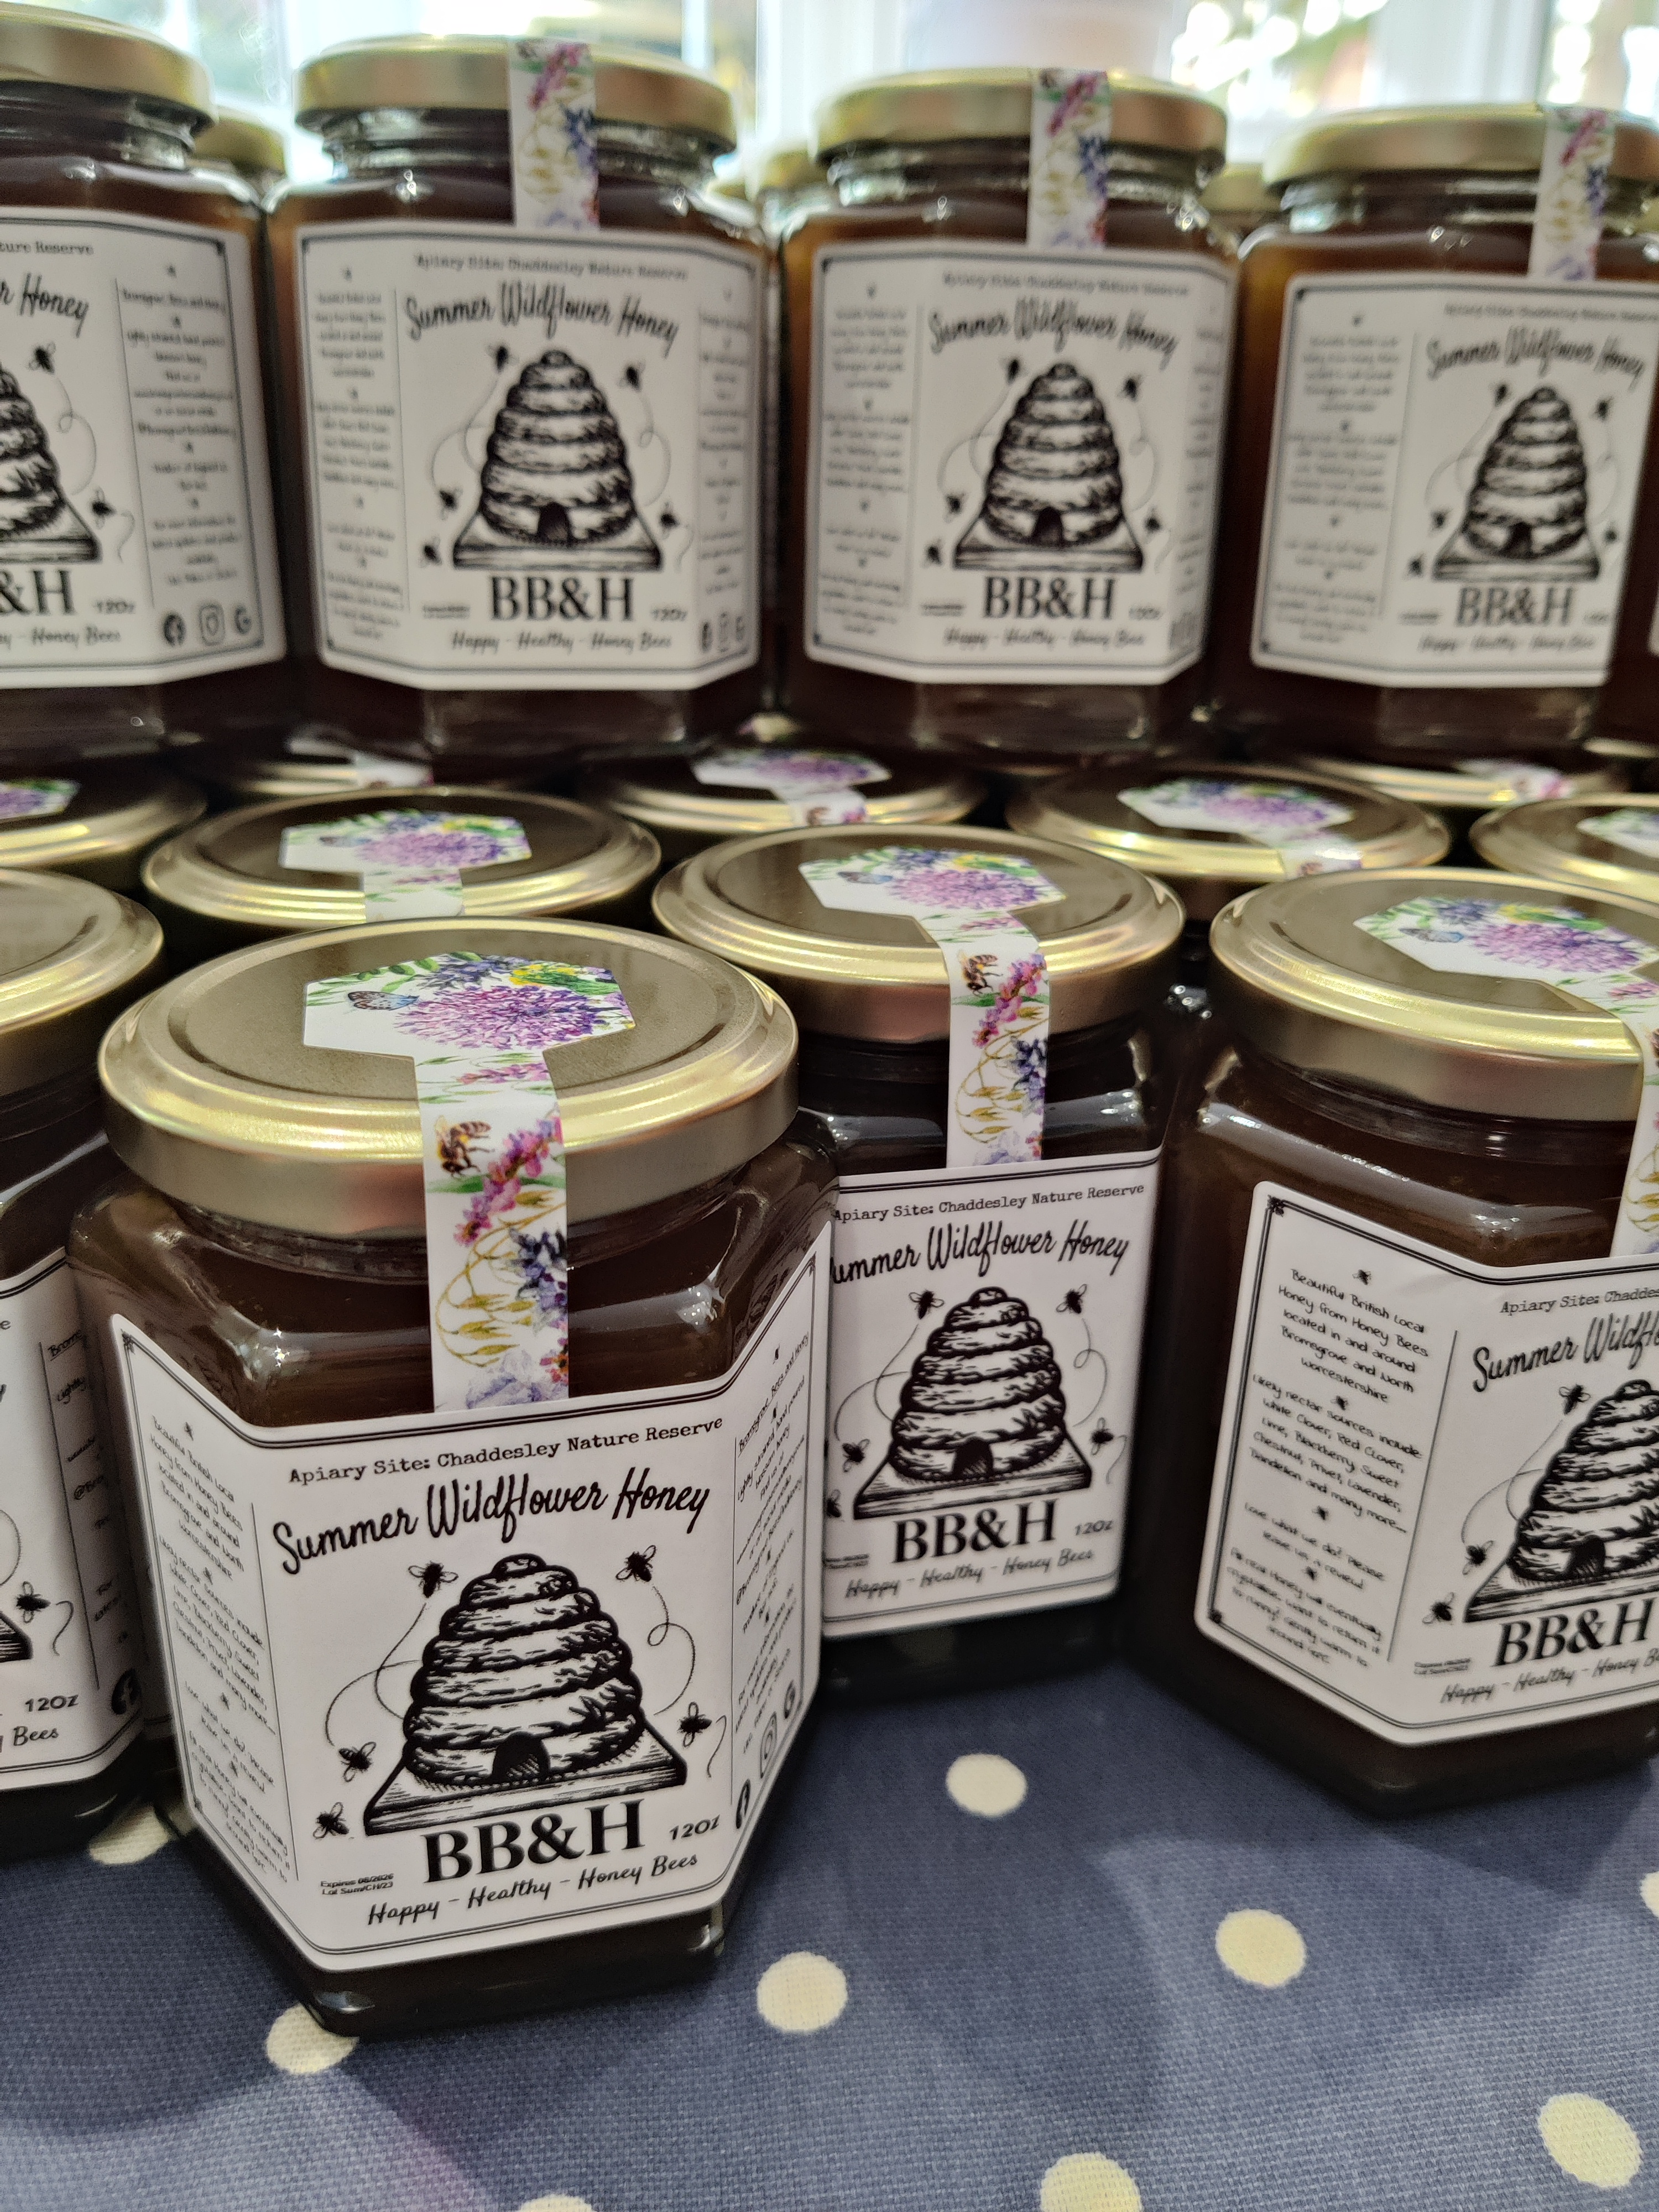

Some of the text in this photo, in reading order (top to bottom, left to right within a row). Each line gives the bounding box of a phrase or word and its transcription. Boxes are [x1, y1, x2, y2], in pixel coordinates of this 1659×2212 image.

[19, 273, 89, 338] Honey
[406, 280, 681, 358] Summer Wildflower Honey
[488, 575, 634, 622] BB&H
[983, 575, 1118, 619] BB&H
[893, 1205, 933, 1217] Site:
[939, 1196, 1026, 1213] Chaddesley
[1031, 1190, 1083, 1204] Nature
[1087, 1183, 1145, 1199] Reserve
[830, 1219, 1130, 1284] ummer Wildflower Honey
[1278, 1285, 1429, 1357] Honey from Honey Bees
[1291, 1268, 1425, 1334] Beautiful British Local
[1500, 1300, 1557, 1316] Apiary
[1559, 1295, 1600, 1308] Site:
[1281, 1325, 1414, 1393] Bromsgrove and North
[1282, 1308, 1417, 1373] located in and around
[1472, 1337, 1579, 1392] Summer
[738, 1332, 809, 1457] Bromsgrove Bees and Honey
[1301, 1358, 1388, 1403] Worcestershire
[152, 1415, 185, 1455] Beautiful
[1285, 1391, 1323, 1412] nectar
[1327, 1410, 1374, 1438] sources
[1336, 1432, 1361, 1451] Red
[150, 1434, 174, 1470] Honey
[194, 1477, 219, 1515] Honey
[289, 1417, 723, 1486] Apiary Site: Chaddesley Nature Reserve
[1360, 1464, 1399, 1489] Sweet
[737, 1469, 753, 1503] Lightly
[1305, 1478, 1328, 1494] and
[273, 1467, 710, 1575] Summer Wildflower Honey
[891, 1498, 1059, 1563] BB&H
[846, 1548, 1093, 1599] Happy Healthy Honey Bees
[1491, 1597, 1658, 1667] BB&H
[1440, 1683, 1495, 1704] Happy
[1513, 1666, 1578, 1692] Healthy
[1592, 1657, 1640, 1678] Honey
[13, 1726, 59, 1746] Bees
[420, 1798, 646, 1884] BB&H
[368, 1853, 698, 1926] Happy Healthy Honey Bees
